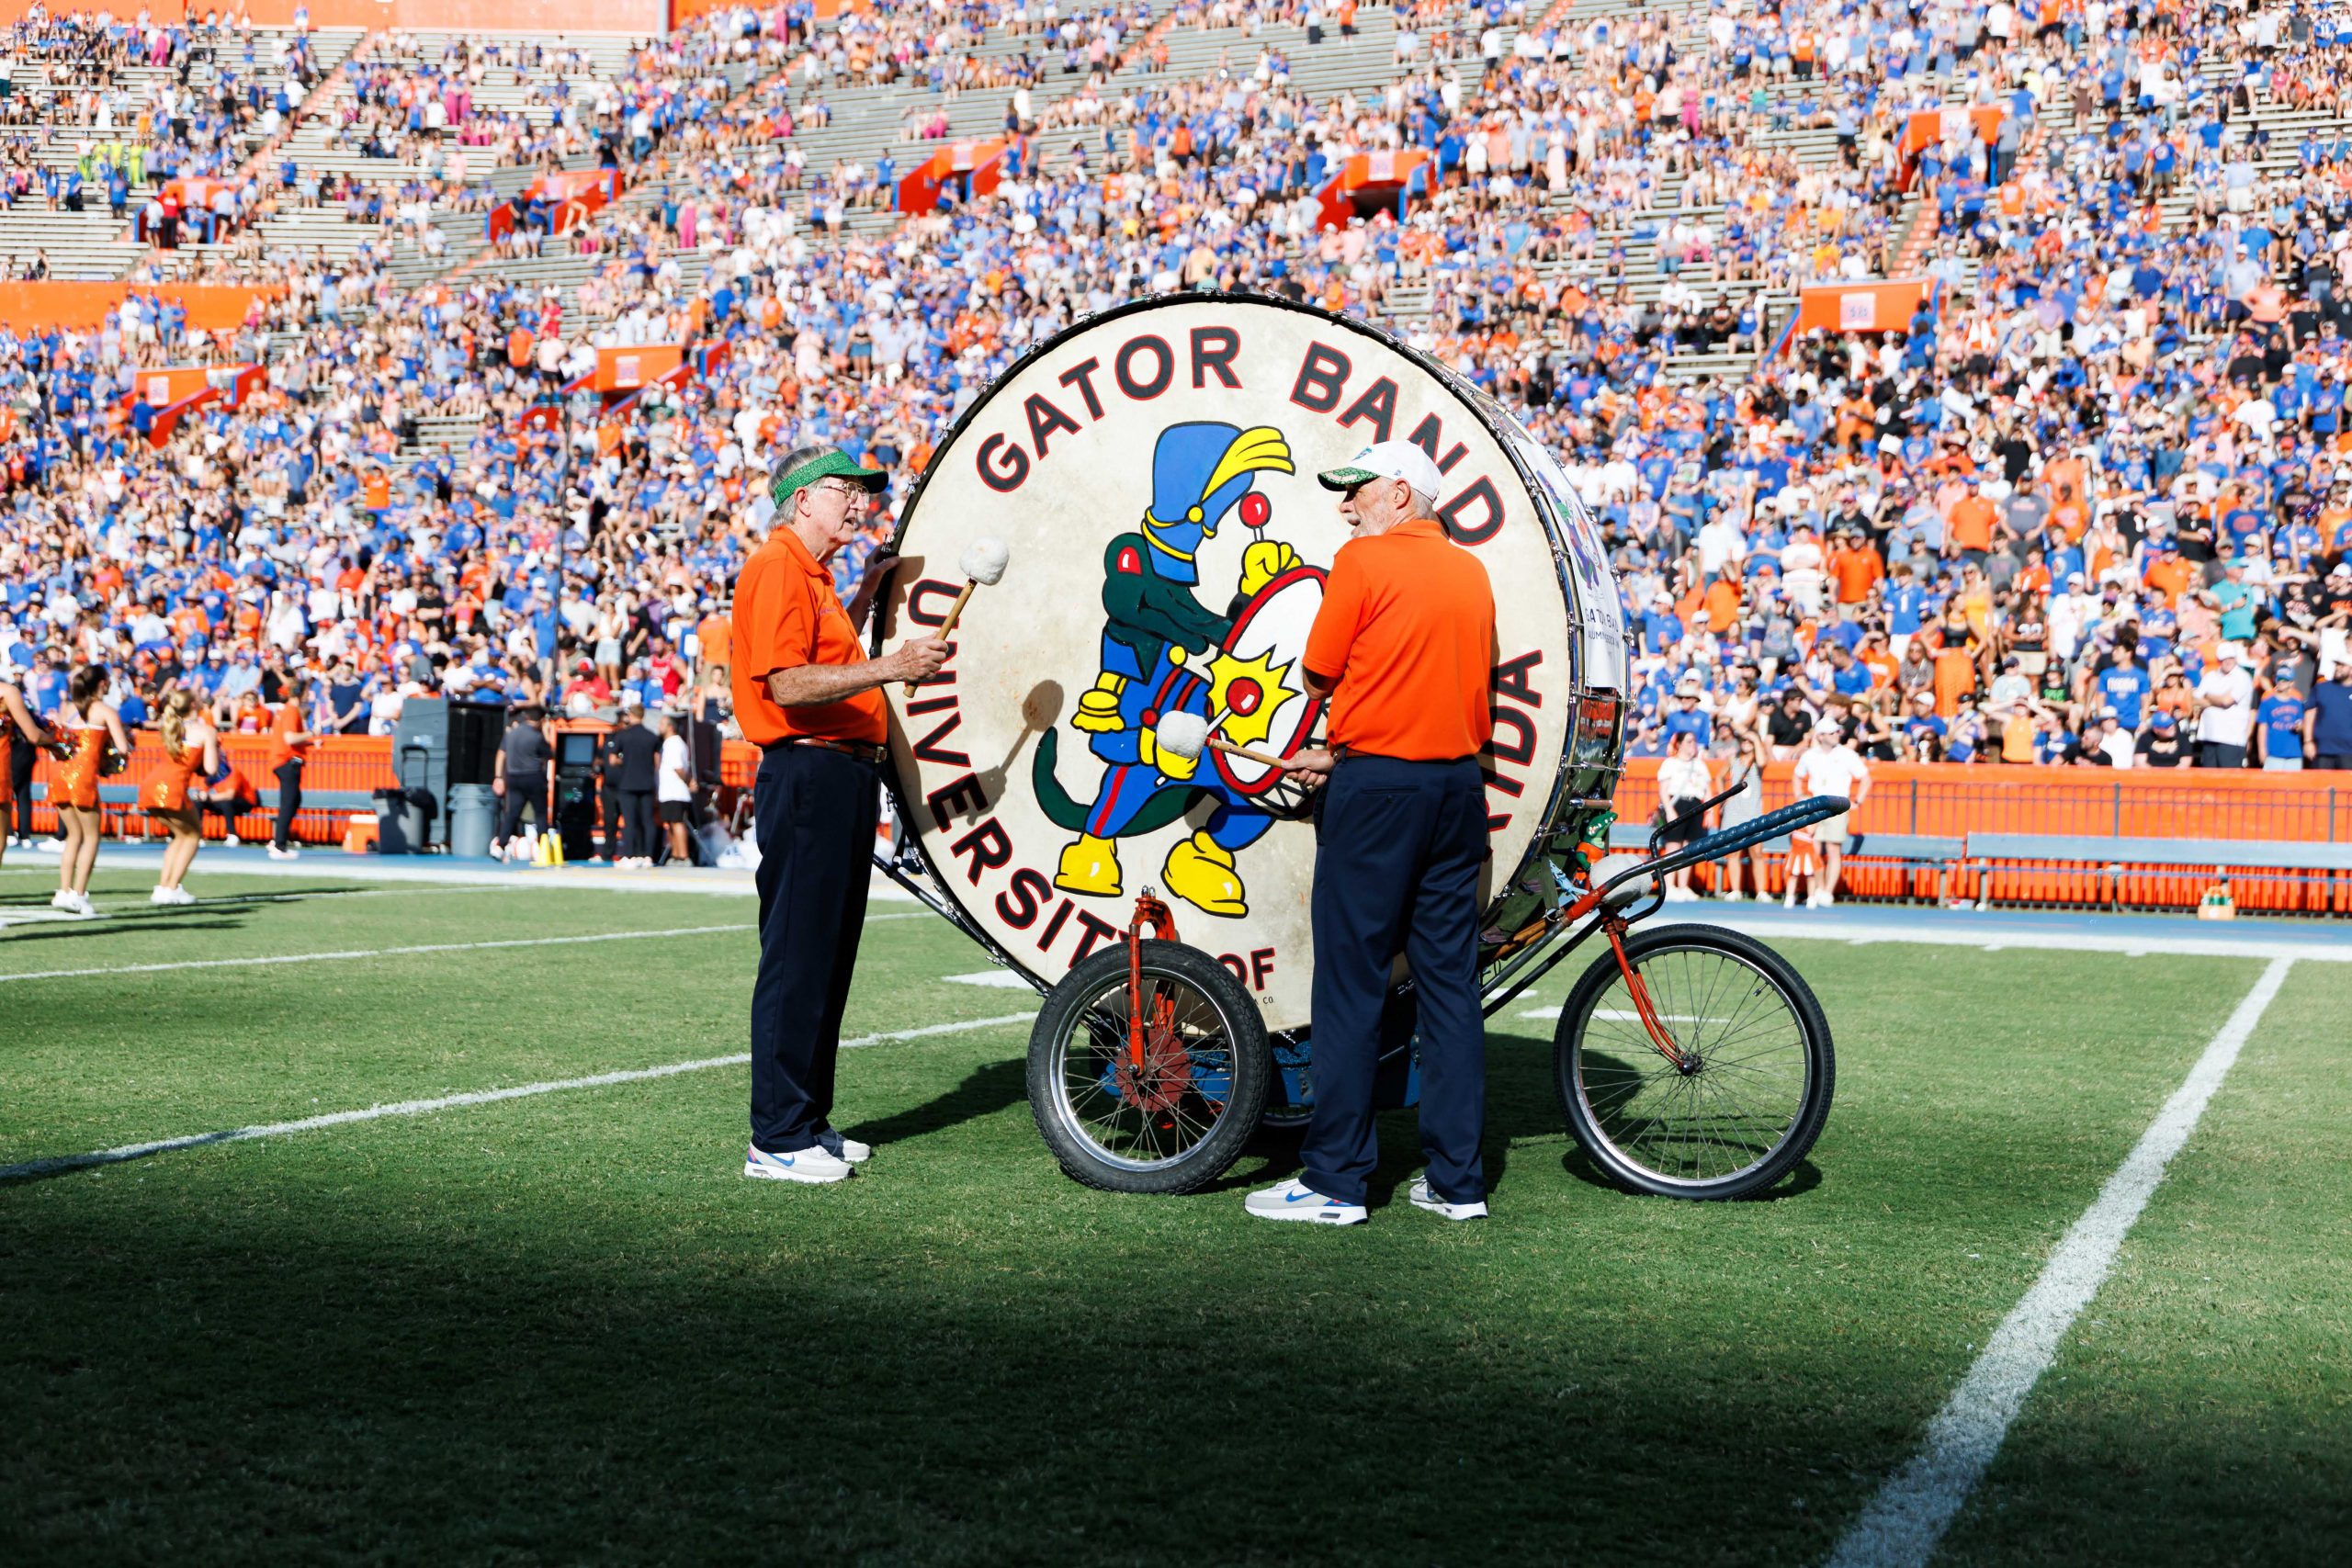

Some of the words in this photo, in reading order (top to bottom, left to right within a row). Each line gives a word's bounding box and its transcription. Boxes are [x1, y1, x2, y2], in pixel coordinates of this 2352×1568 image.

[976, 325, 1242, 492] GATOR
[1290, 341, 1505, 547] BAND
[906, 579, 1130, 971] UIVERSIT
[1216, 947, 1276, 991] OF
